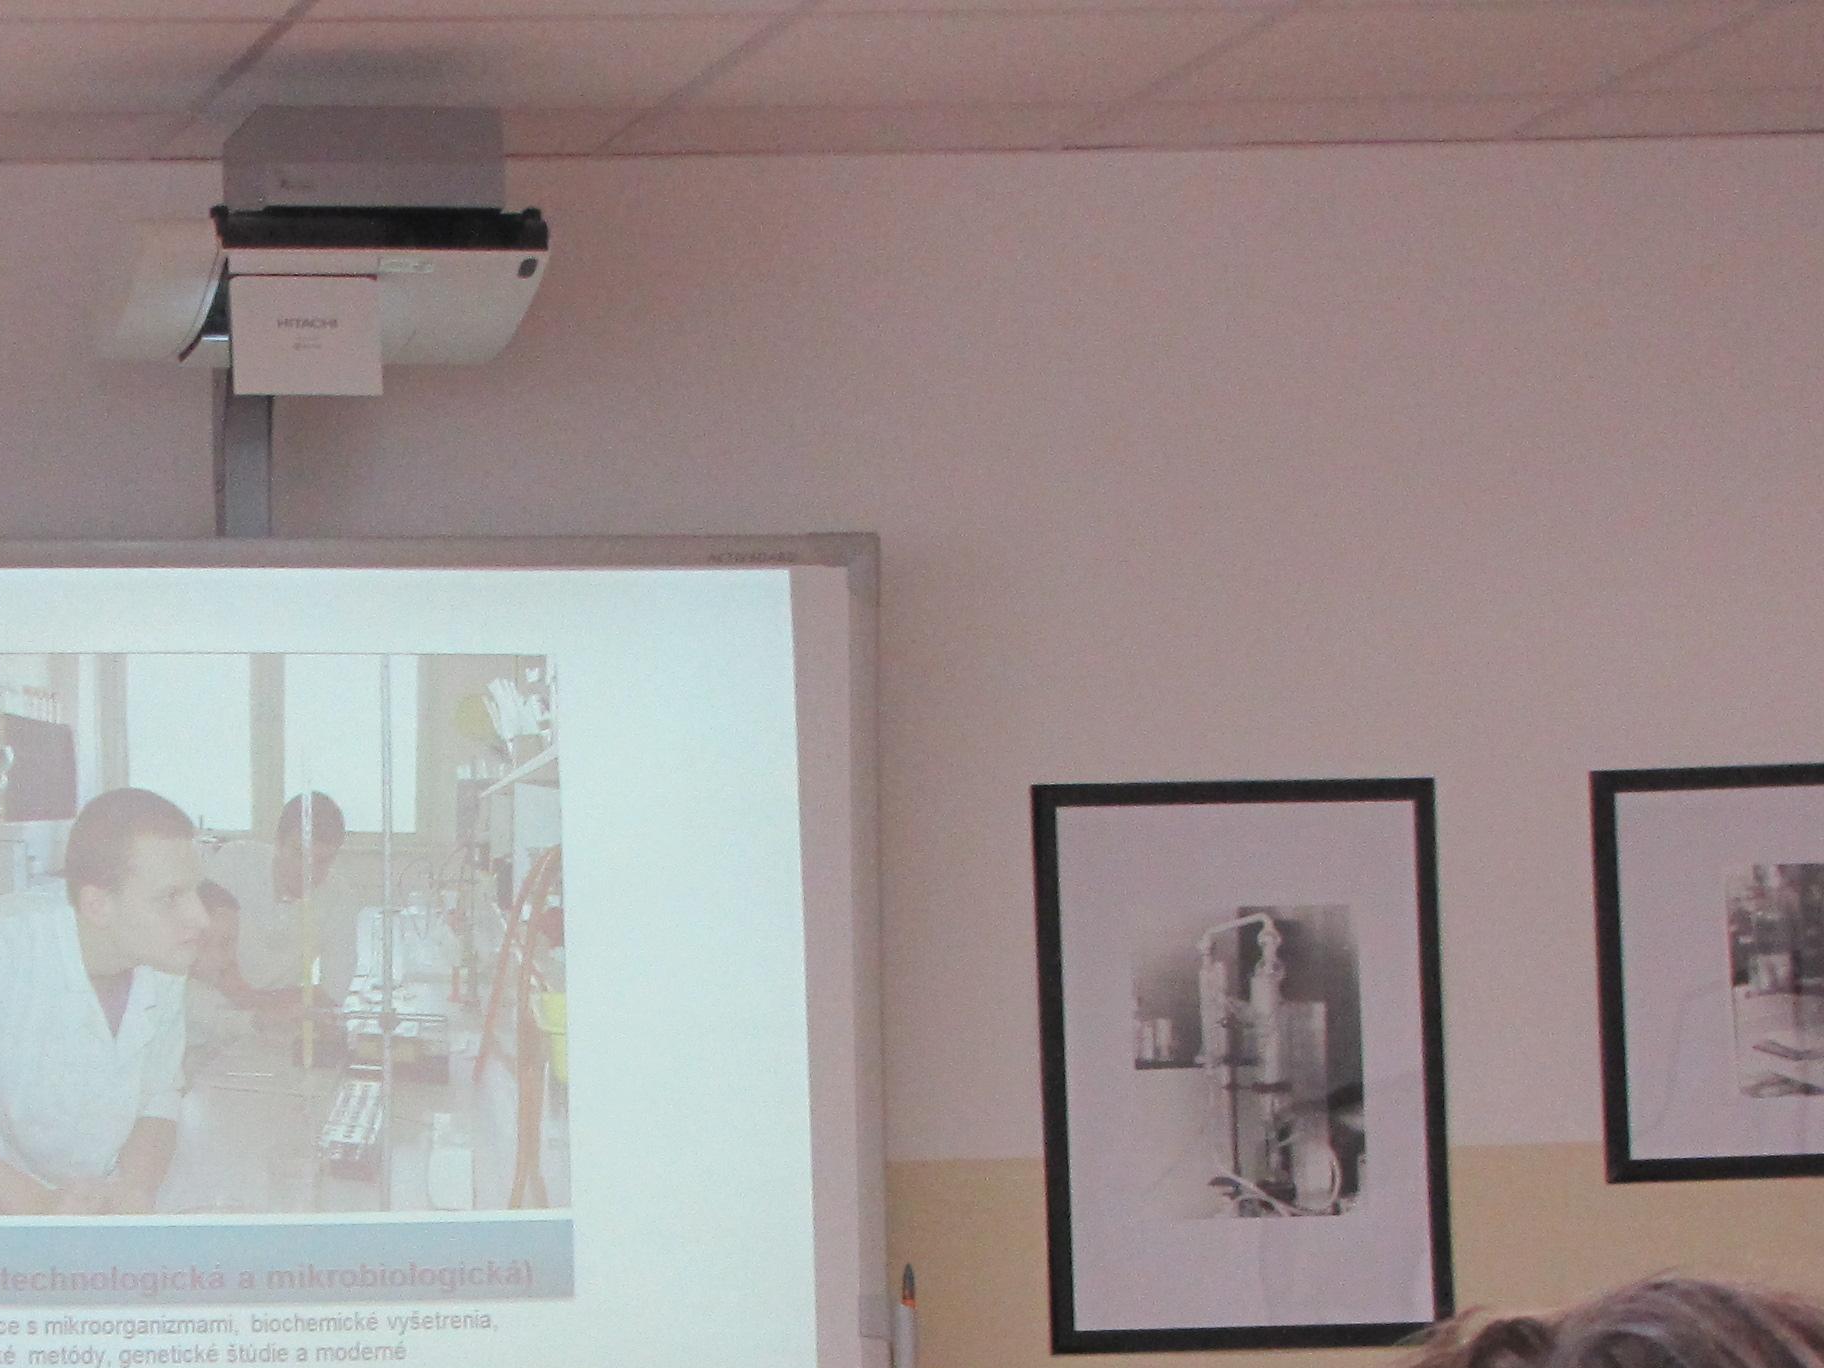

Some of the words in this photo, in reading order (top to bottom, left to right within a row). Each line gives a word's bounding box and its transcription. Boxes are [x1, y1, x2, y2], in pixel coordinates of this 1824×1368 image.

[277, 318, 338, 329] HITACHI
[237, 1269, 256, 1290] a
[266, 1259, 534, 1293] mikrobiologická)
[27, 1322, 38, 1335] s
[44, 1313, 240, 1339] mikroorganizmami,
[251, 1311, 378, 1334] biochemické
[387, 1308, 500, 1336] vyšetrenia,
[28, 1346, 113, 1368] metódy,
[226, 1341, 290, 1363] štúdie
[295, 1347, 309, 1363] a
[315, 1340, 409, 1362] moderné
